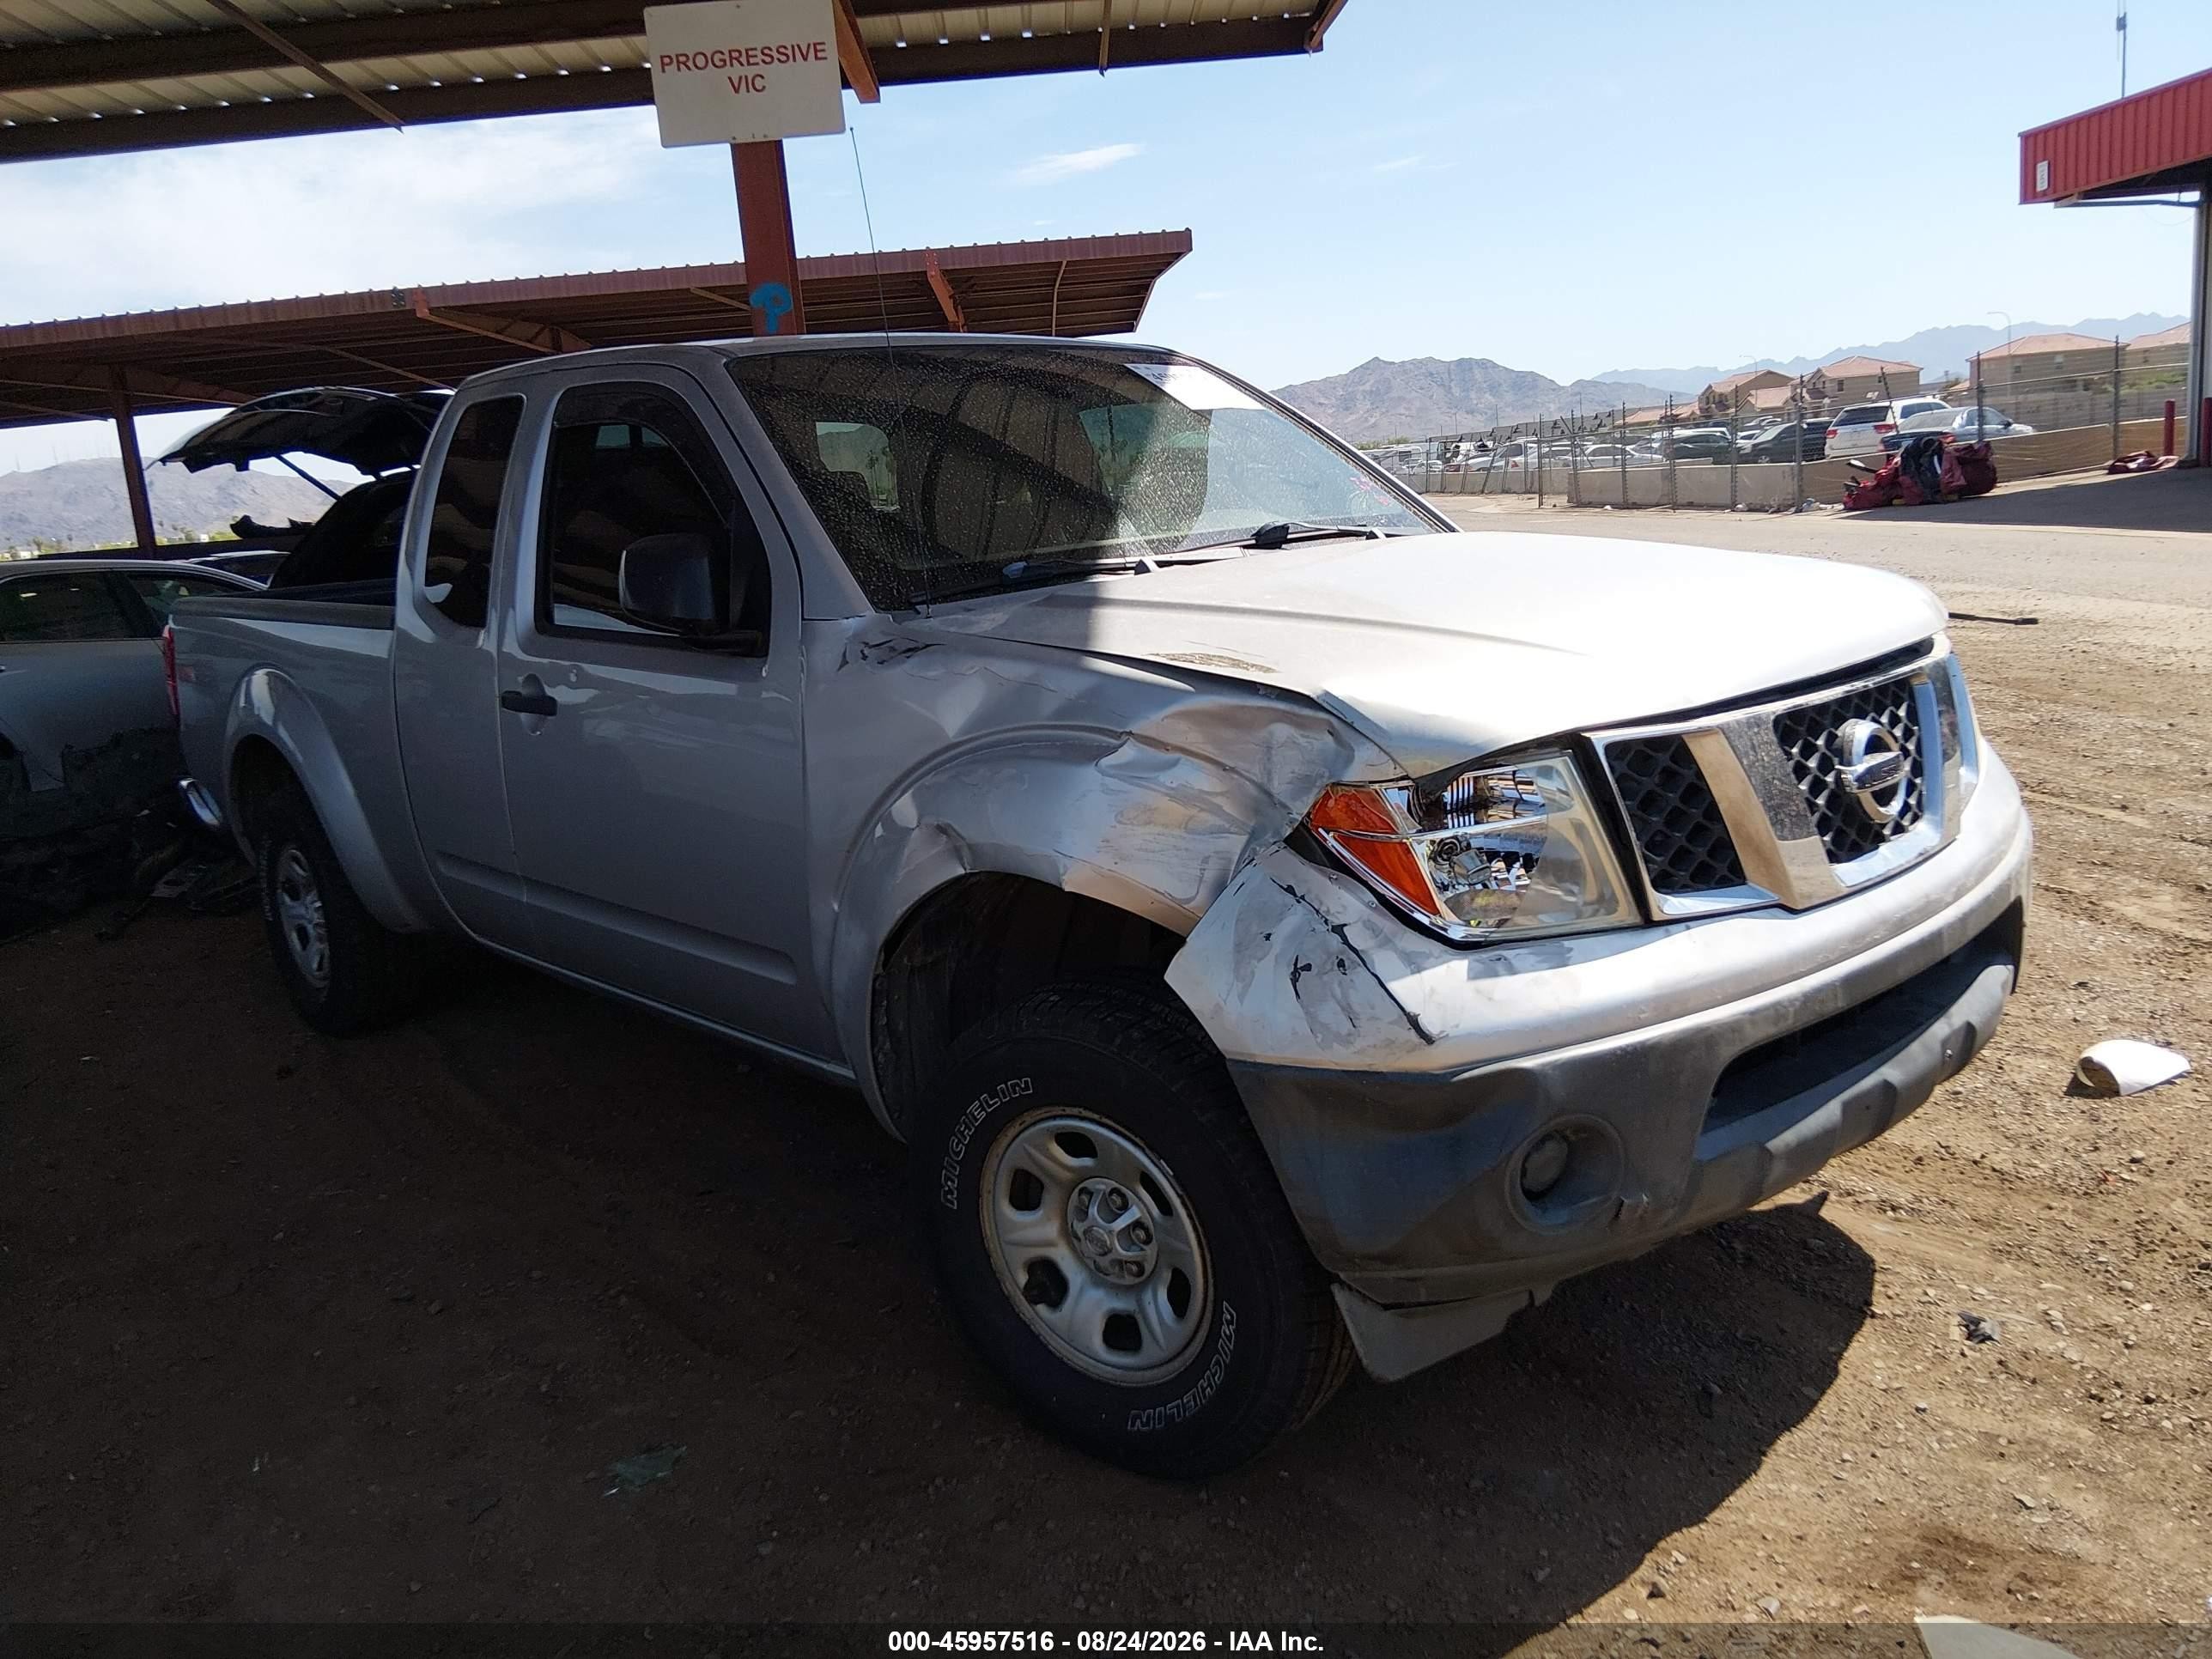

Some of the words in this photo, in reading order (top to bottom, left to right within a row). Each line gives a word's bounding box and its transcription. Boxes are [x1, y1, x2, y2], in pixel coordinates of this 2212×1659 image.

[659, 42, 828, 73] PROGRESSIVE
[727, 74, 767, 94] VIC
[941, 1078, 1033, 1209] MICHELIN
[1127, 1300, 1237, 1431] MICHELIN
